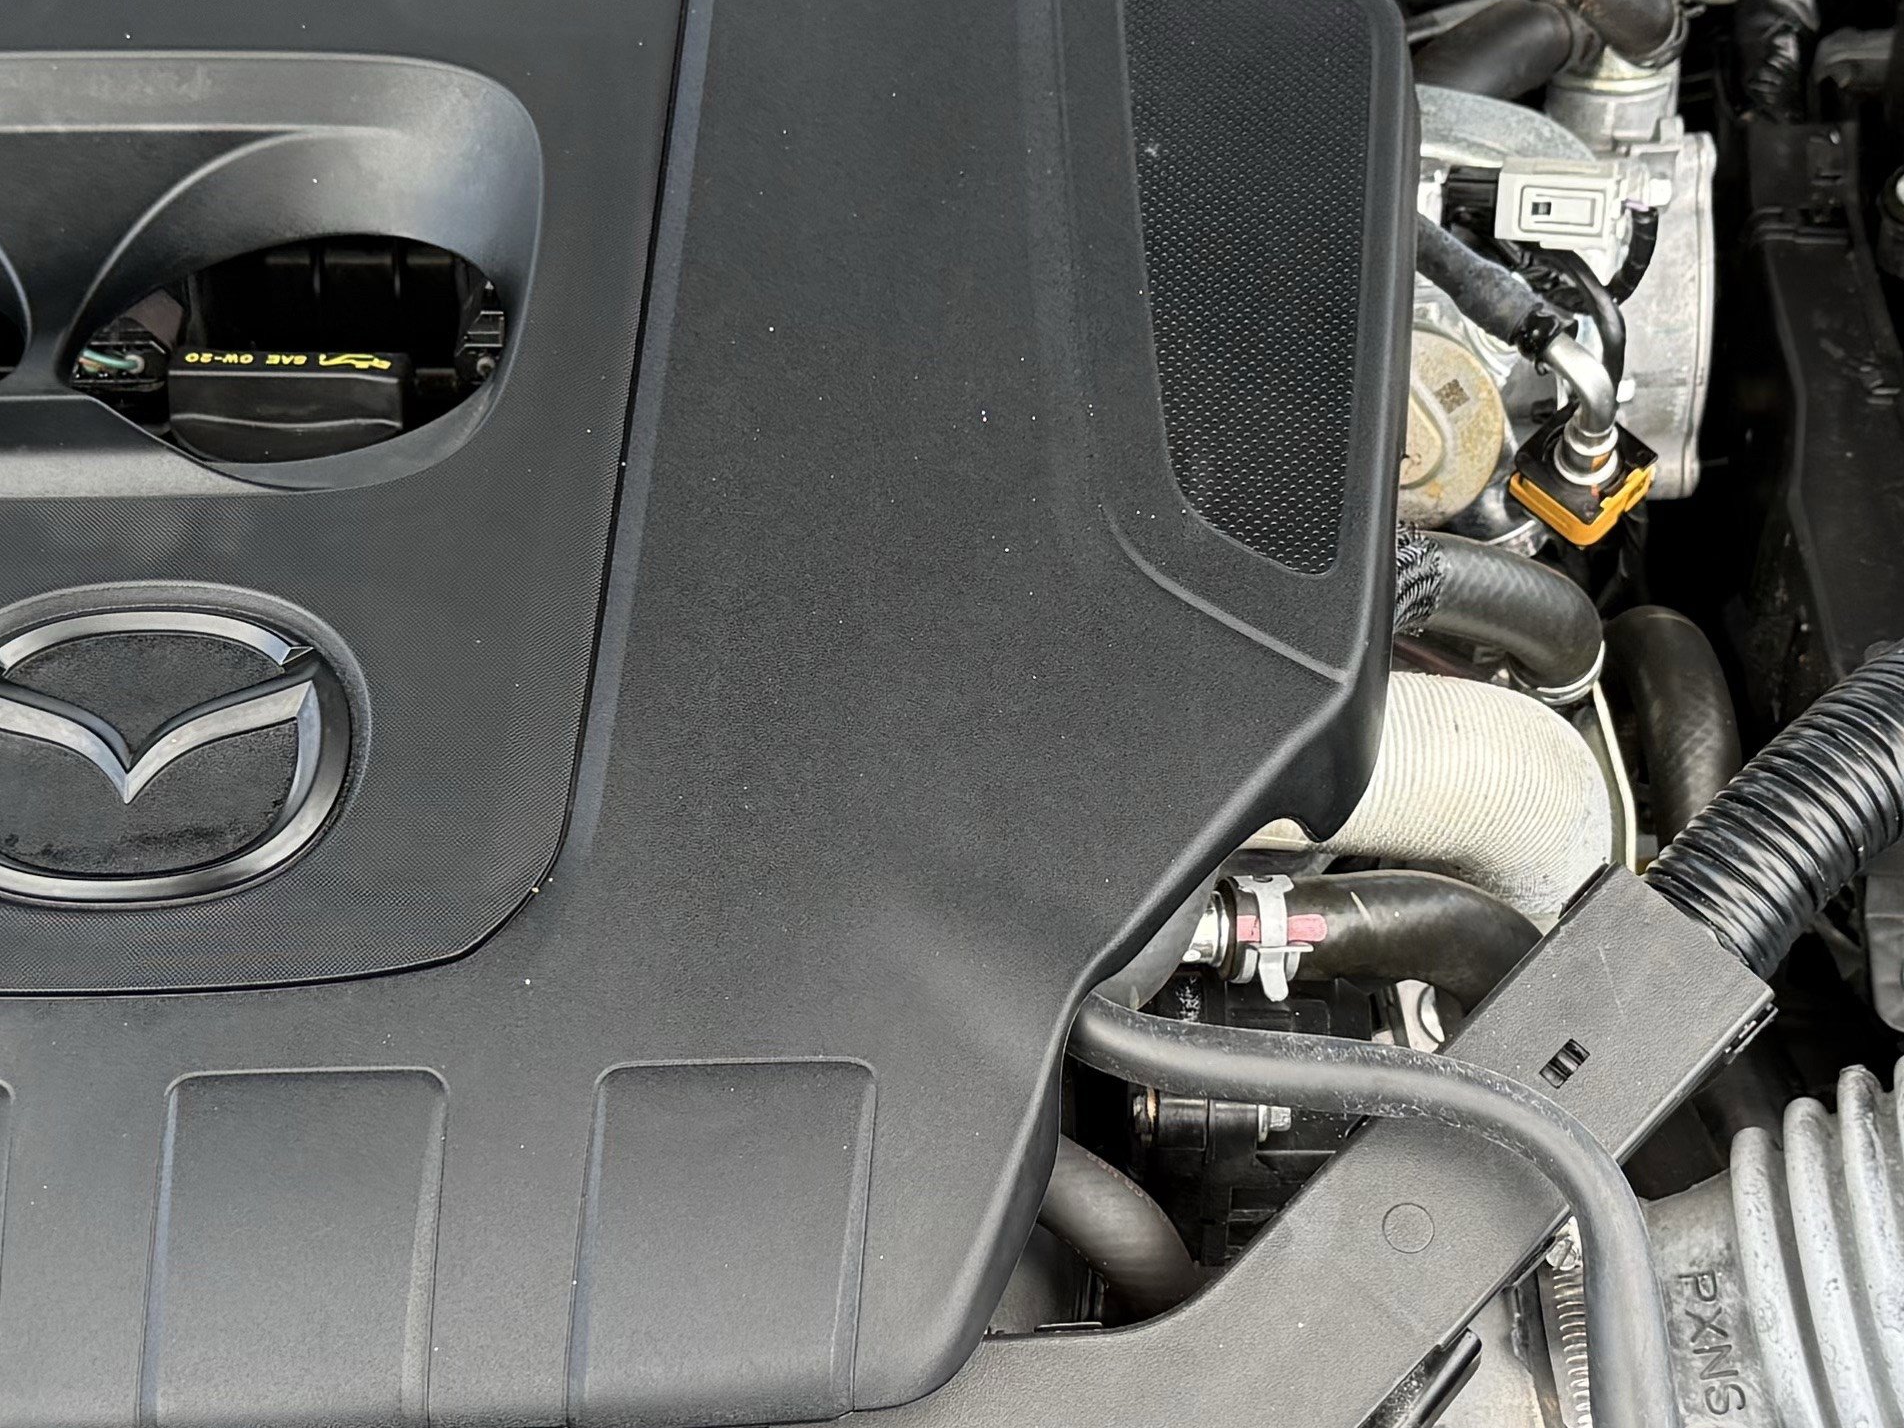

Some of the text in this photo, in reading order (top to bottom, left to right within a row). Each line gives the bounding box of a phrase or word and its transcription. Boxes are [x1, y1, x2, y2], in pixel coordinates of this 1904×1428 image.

[184, 352, 308, 365] SAE 0W-20
[1678, 1269, 1746, 1415] PXNS
